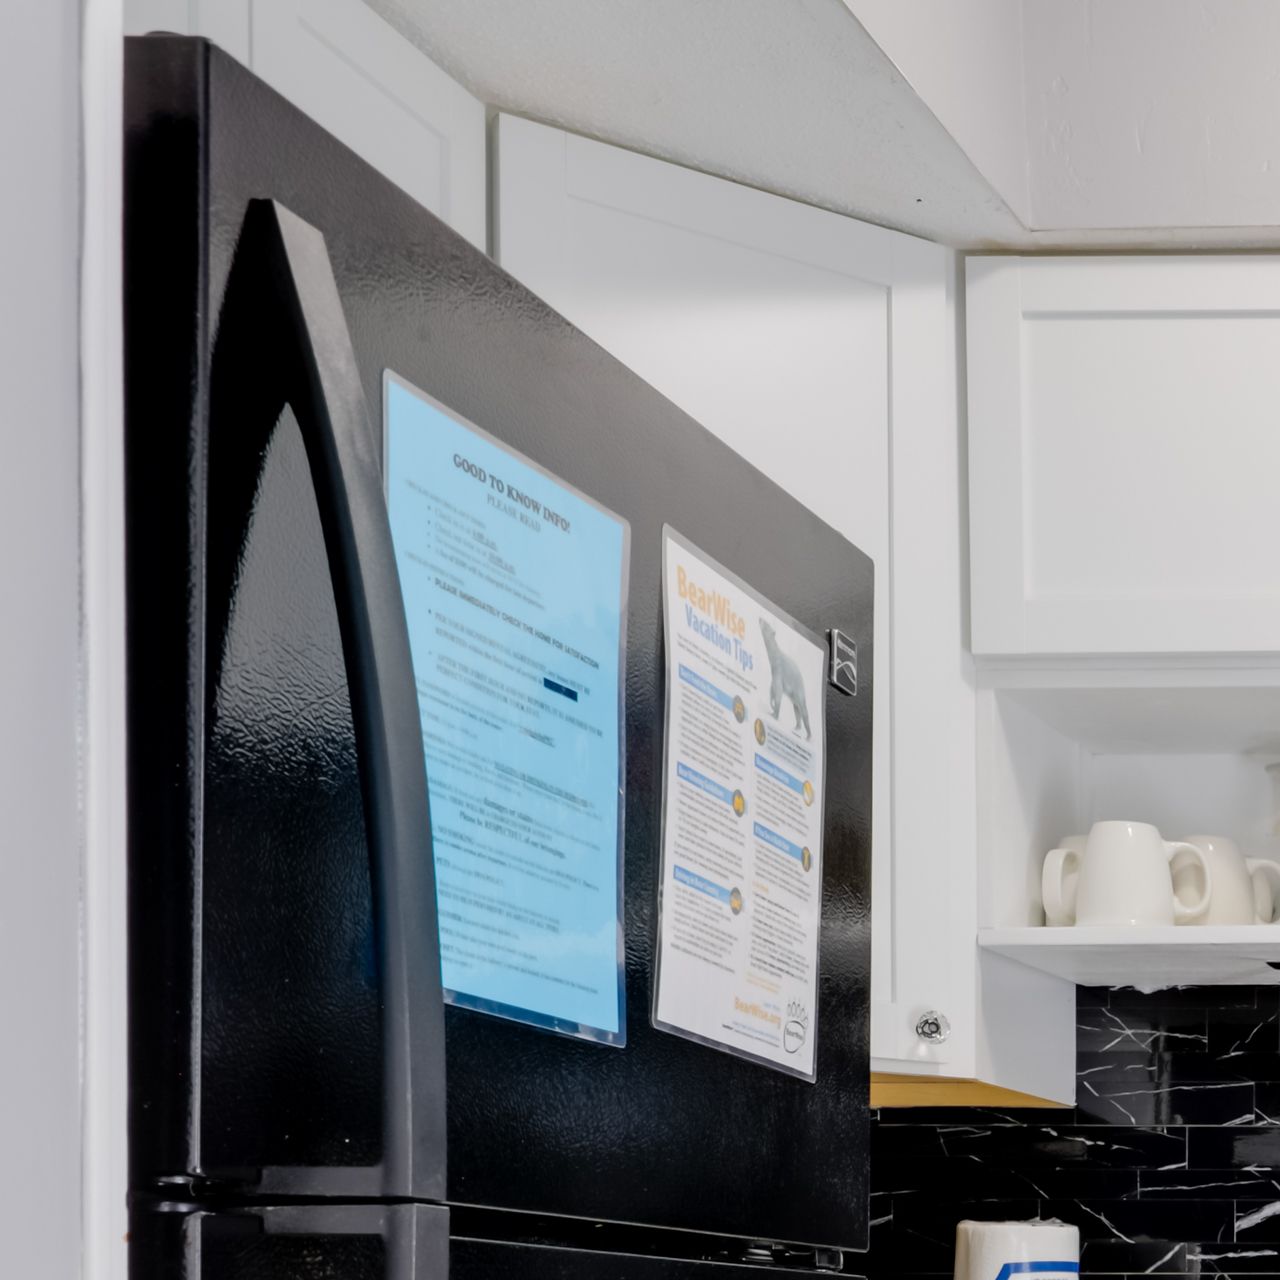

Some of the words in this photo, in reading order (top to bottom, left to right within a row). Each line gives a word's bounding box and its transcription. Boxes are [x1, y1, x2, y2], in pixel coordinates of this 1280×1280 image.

[453, 453, 487, 483] GOOD
[489, 474, 504, 494] TO
[507, 484, 542, 515] KNOW
[543, 506, 571, 534] INFO!
[486, 493, 518, 521] PLEASE
[676, 564, 747, 640] BearWise
[685, 603, 731, 658] Vacation
[733, 637, 755, 672] Tips
